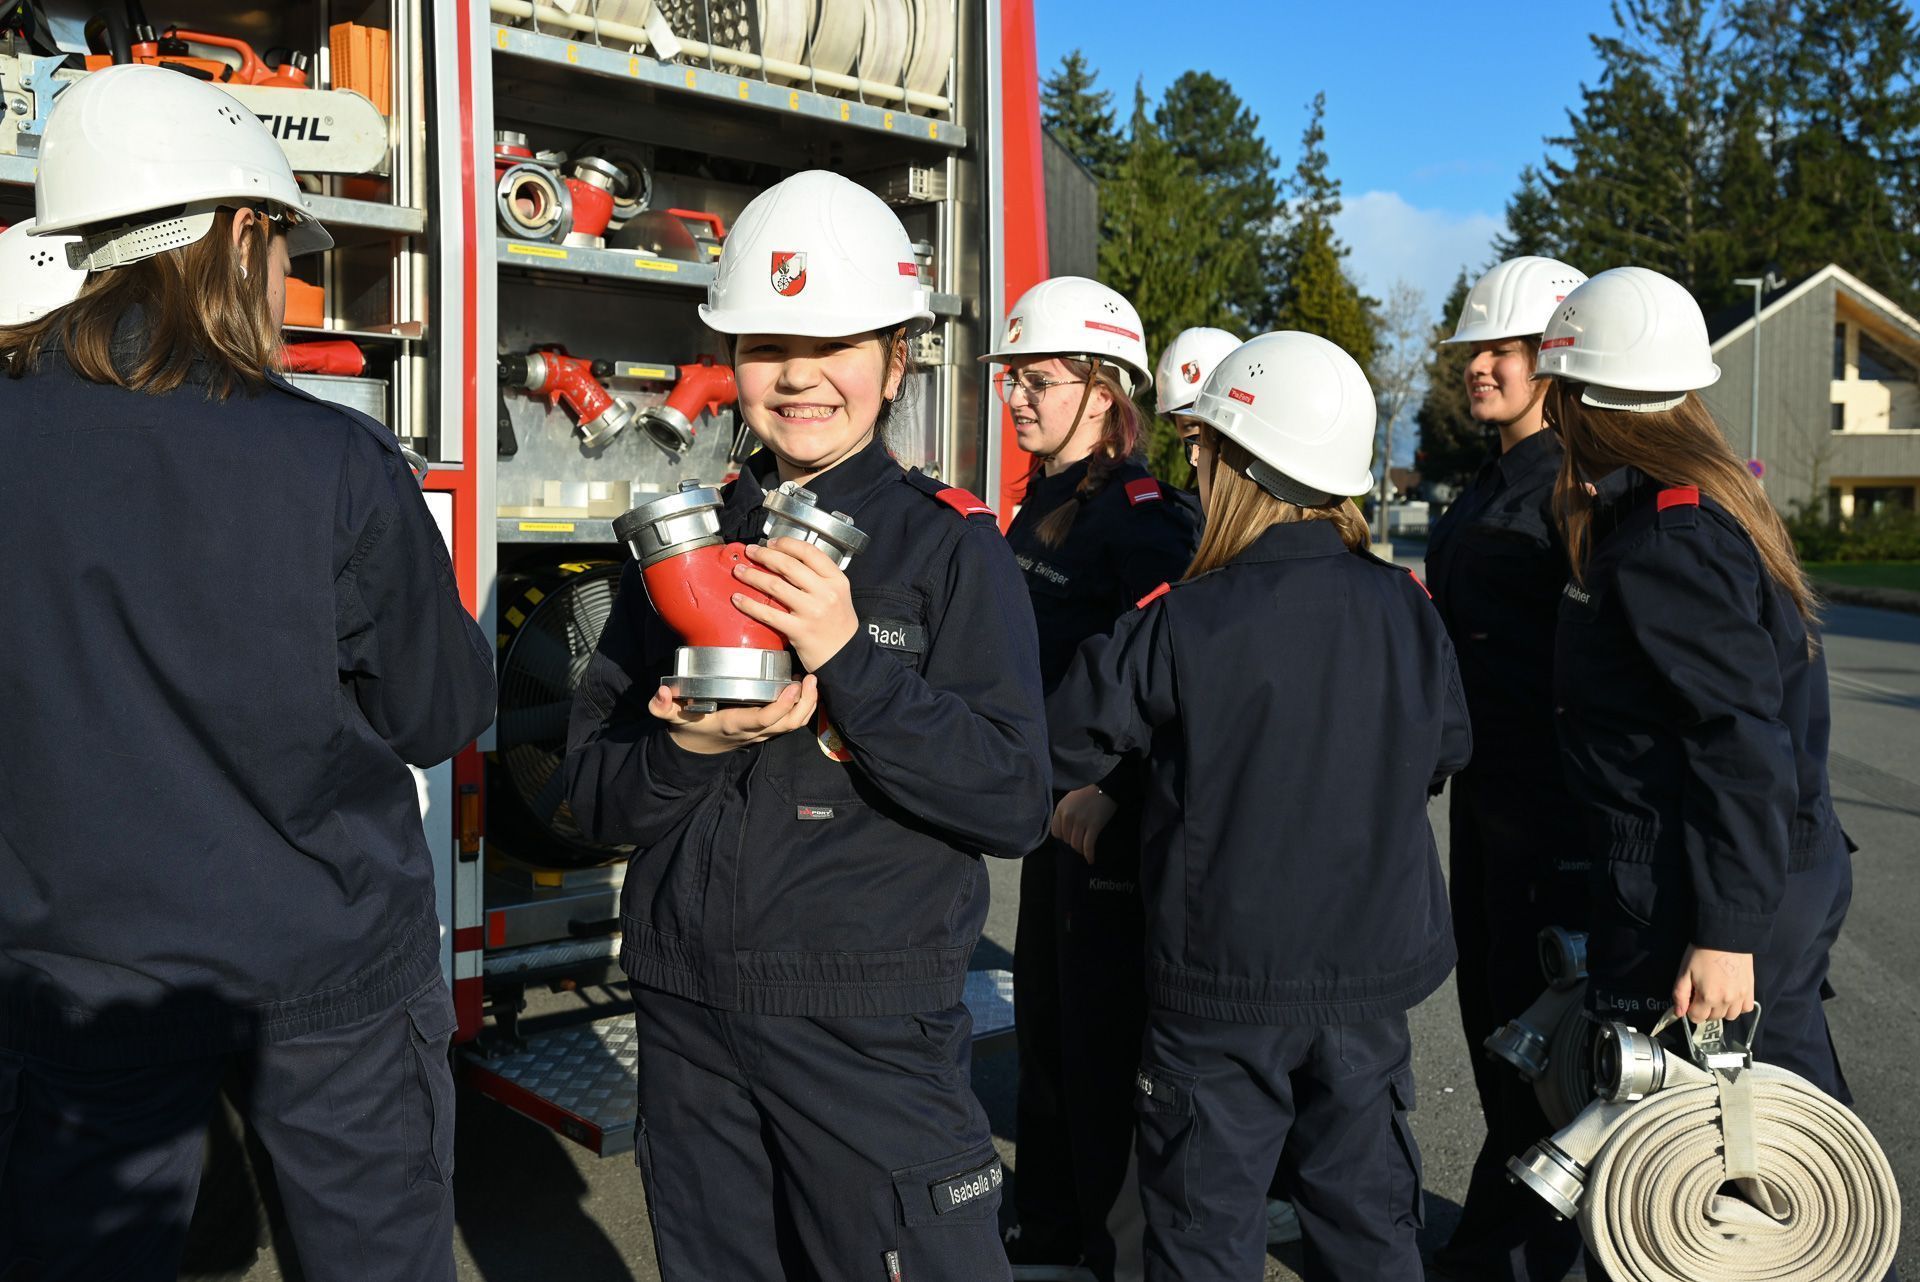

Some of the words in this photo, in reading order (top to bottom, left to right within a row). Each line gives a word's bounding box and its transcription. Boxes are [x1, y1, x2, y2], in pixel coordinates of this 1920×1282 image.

[497, 29, 508, 48] C
[568, 45, 578, 64] C
[629, 57, 639, 77] C
[685, 70, 696, 89] C
[739, 81, 748, 99] C
[790, 92, 799, 110] C
[841, 104, 849, 121] C
[884, 113, 893, 129] C
[255, 114, 330, 142] TIHL
[929, 122, 938, 139] C
[1035, 562, 1069, 585] Ewinger
[868, 623, 906, 647] Rack
[1089, 877, 1136, 895] Kimberly
[1610, 994, 1639, 1012] Leya
[948, 1174, 990, 1205] Isabella
